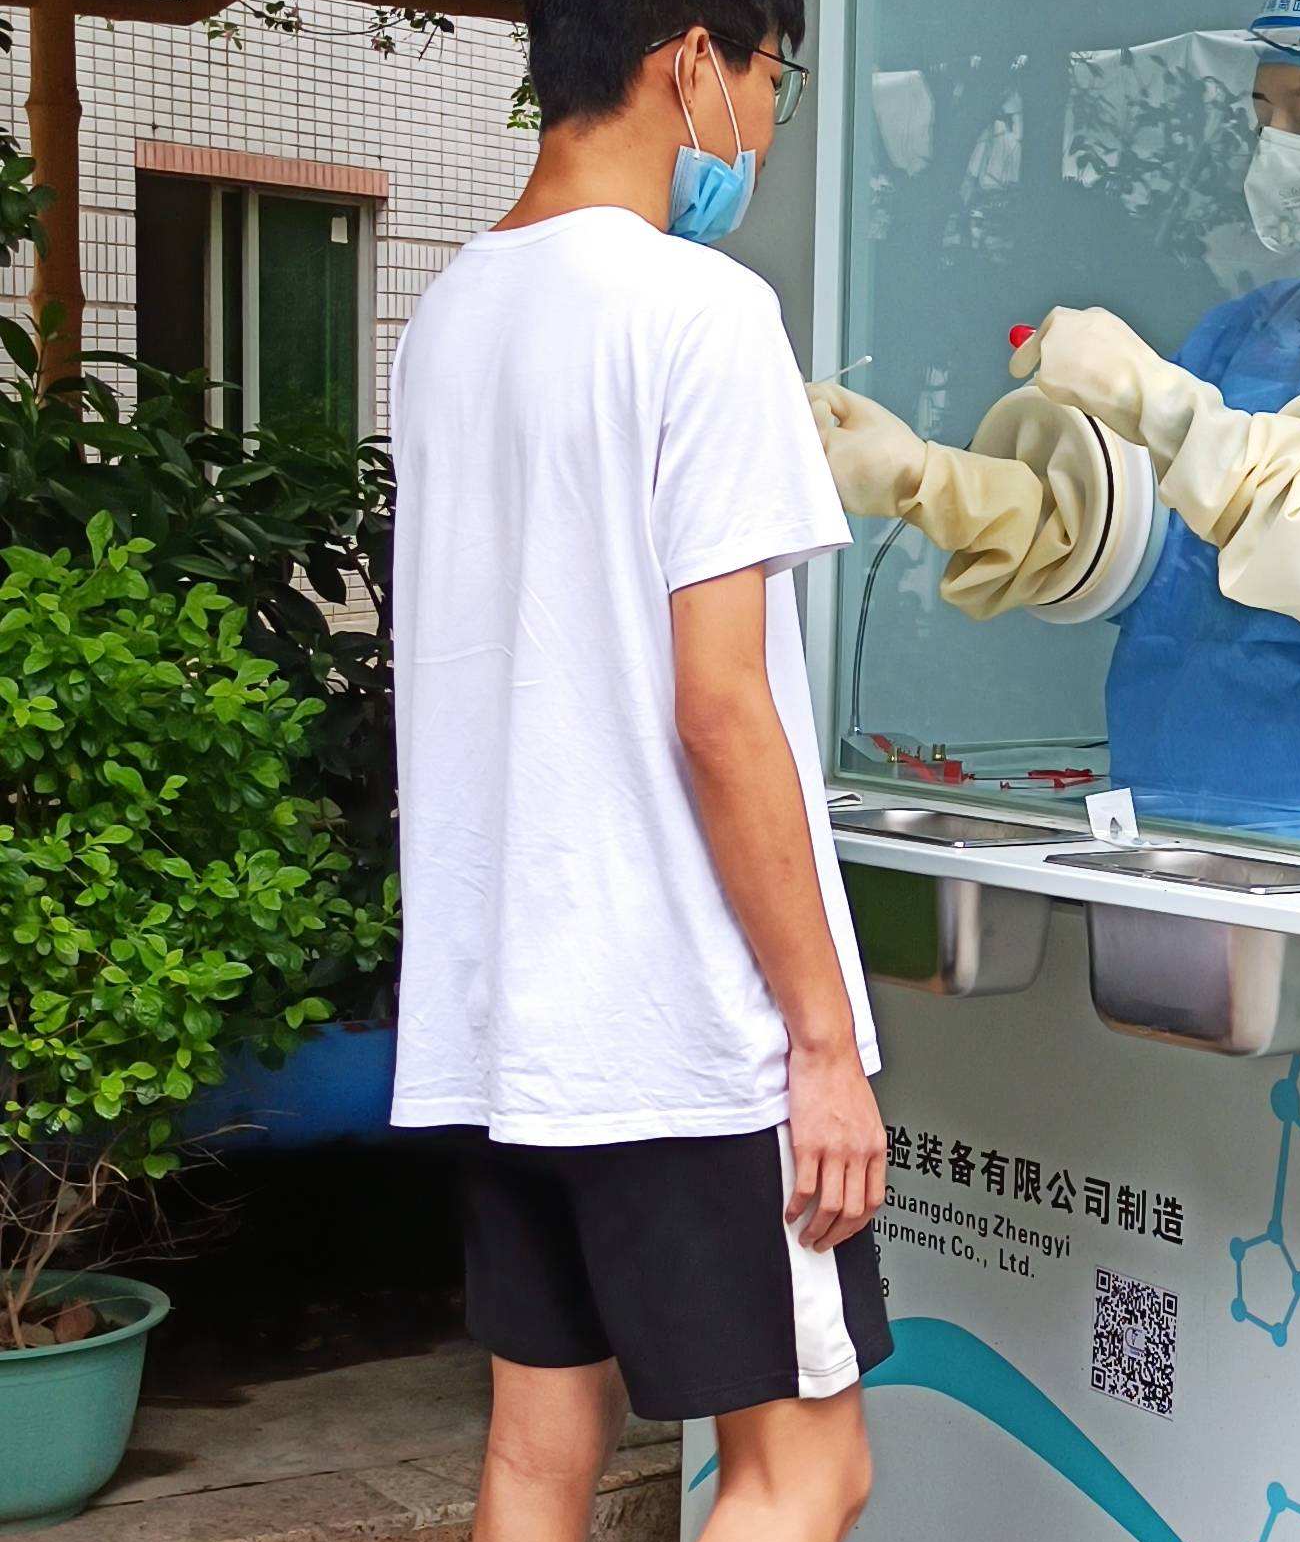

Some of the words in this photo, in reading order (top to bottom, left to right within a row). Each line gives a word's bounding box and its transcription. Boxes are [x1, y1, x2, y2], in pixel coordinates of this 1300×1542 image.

[884, 1184, 988, 1238] Guangdong
[992, 1214, 1071, 1259] Zhengyi
[885, 1124, 1185, 1246] 验装备有限公司制造
[999, 1247, 1036, 1278] Ltd.
